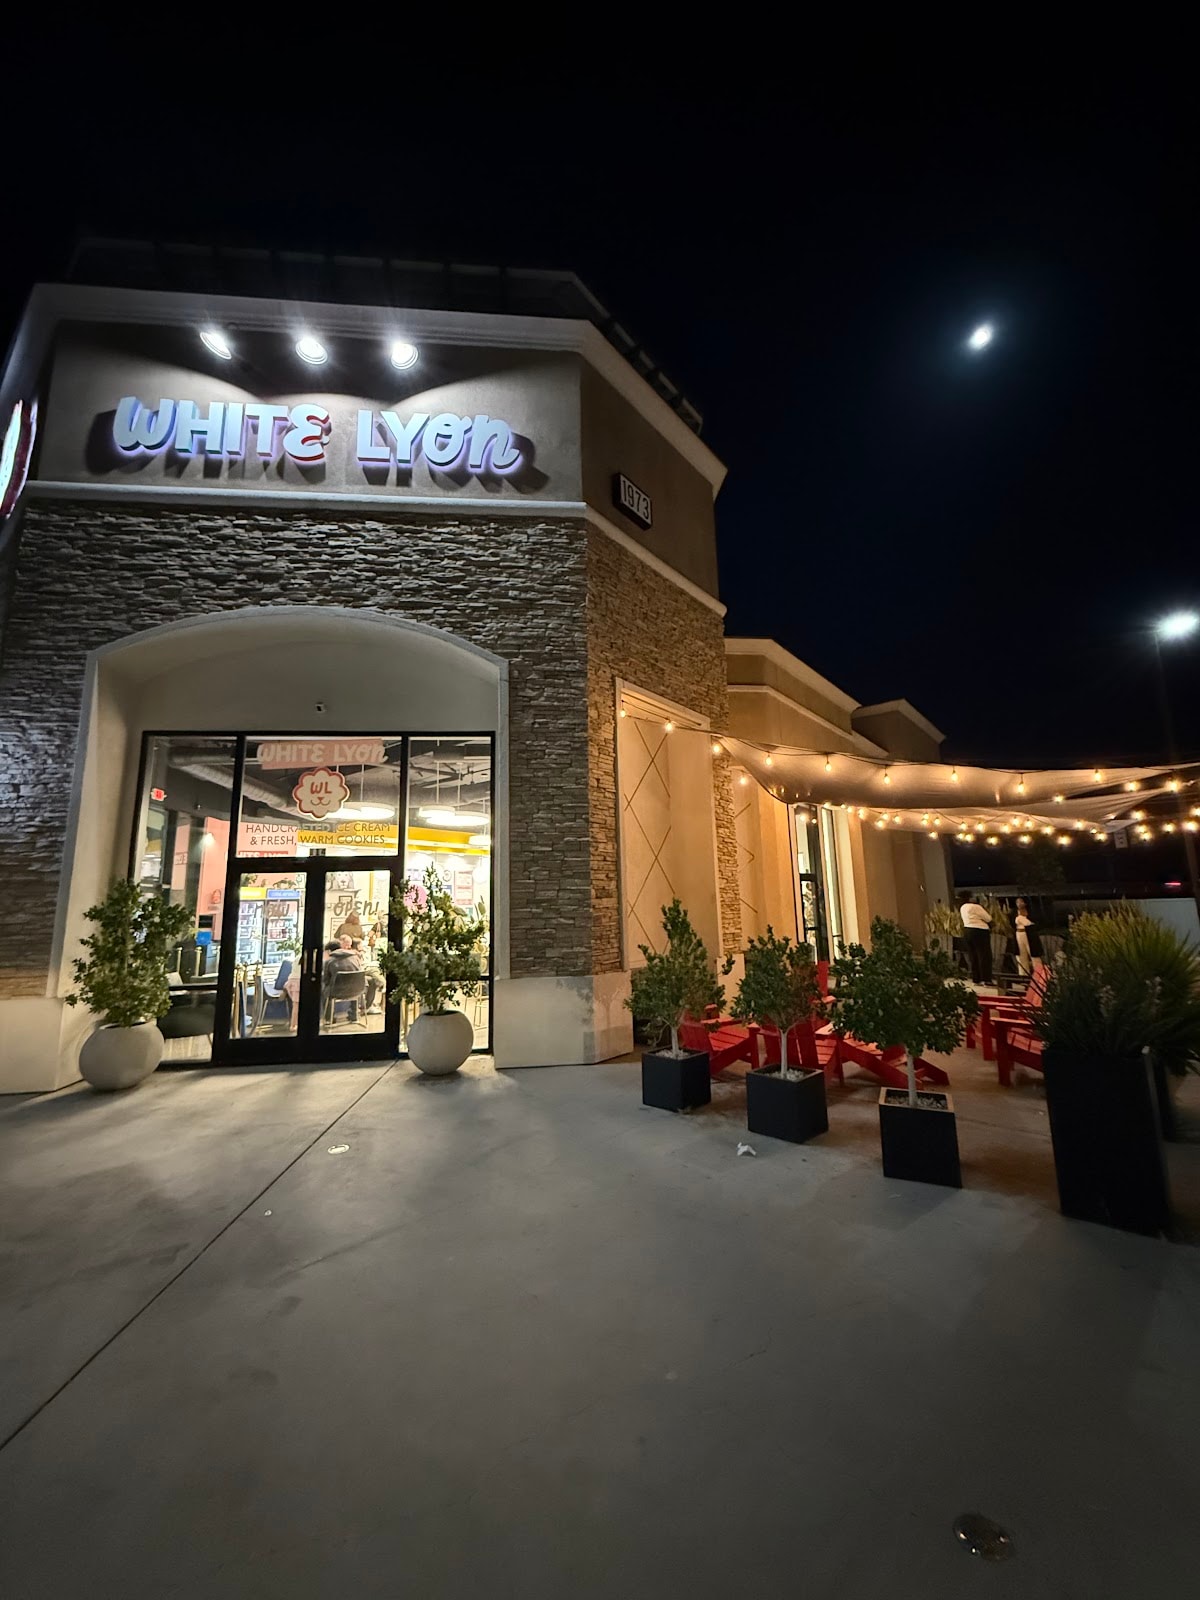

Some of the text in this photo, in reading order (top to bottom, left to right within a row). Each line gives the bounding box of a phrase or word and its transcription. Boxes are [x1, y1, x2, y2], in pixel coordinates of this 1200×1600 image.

[112, 396, 329, 462] WHITE
[622, 480, 649, 520] 1973
[256, 743, 324, 763] WHITE
[310, 781, 333, 795] WL
[353, 822, 391, 832] CREAM
[249, 834, 385, 846] & FRESH, WARM COOKIES
